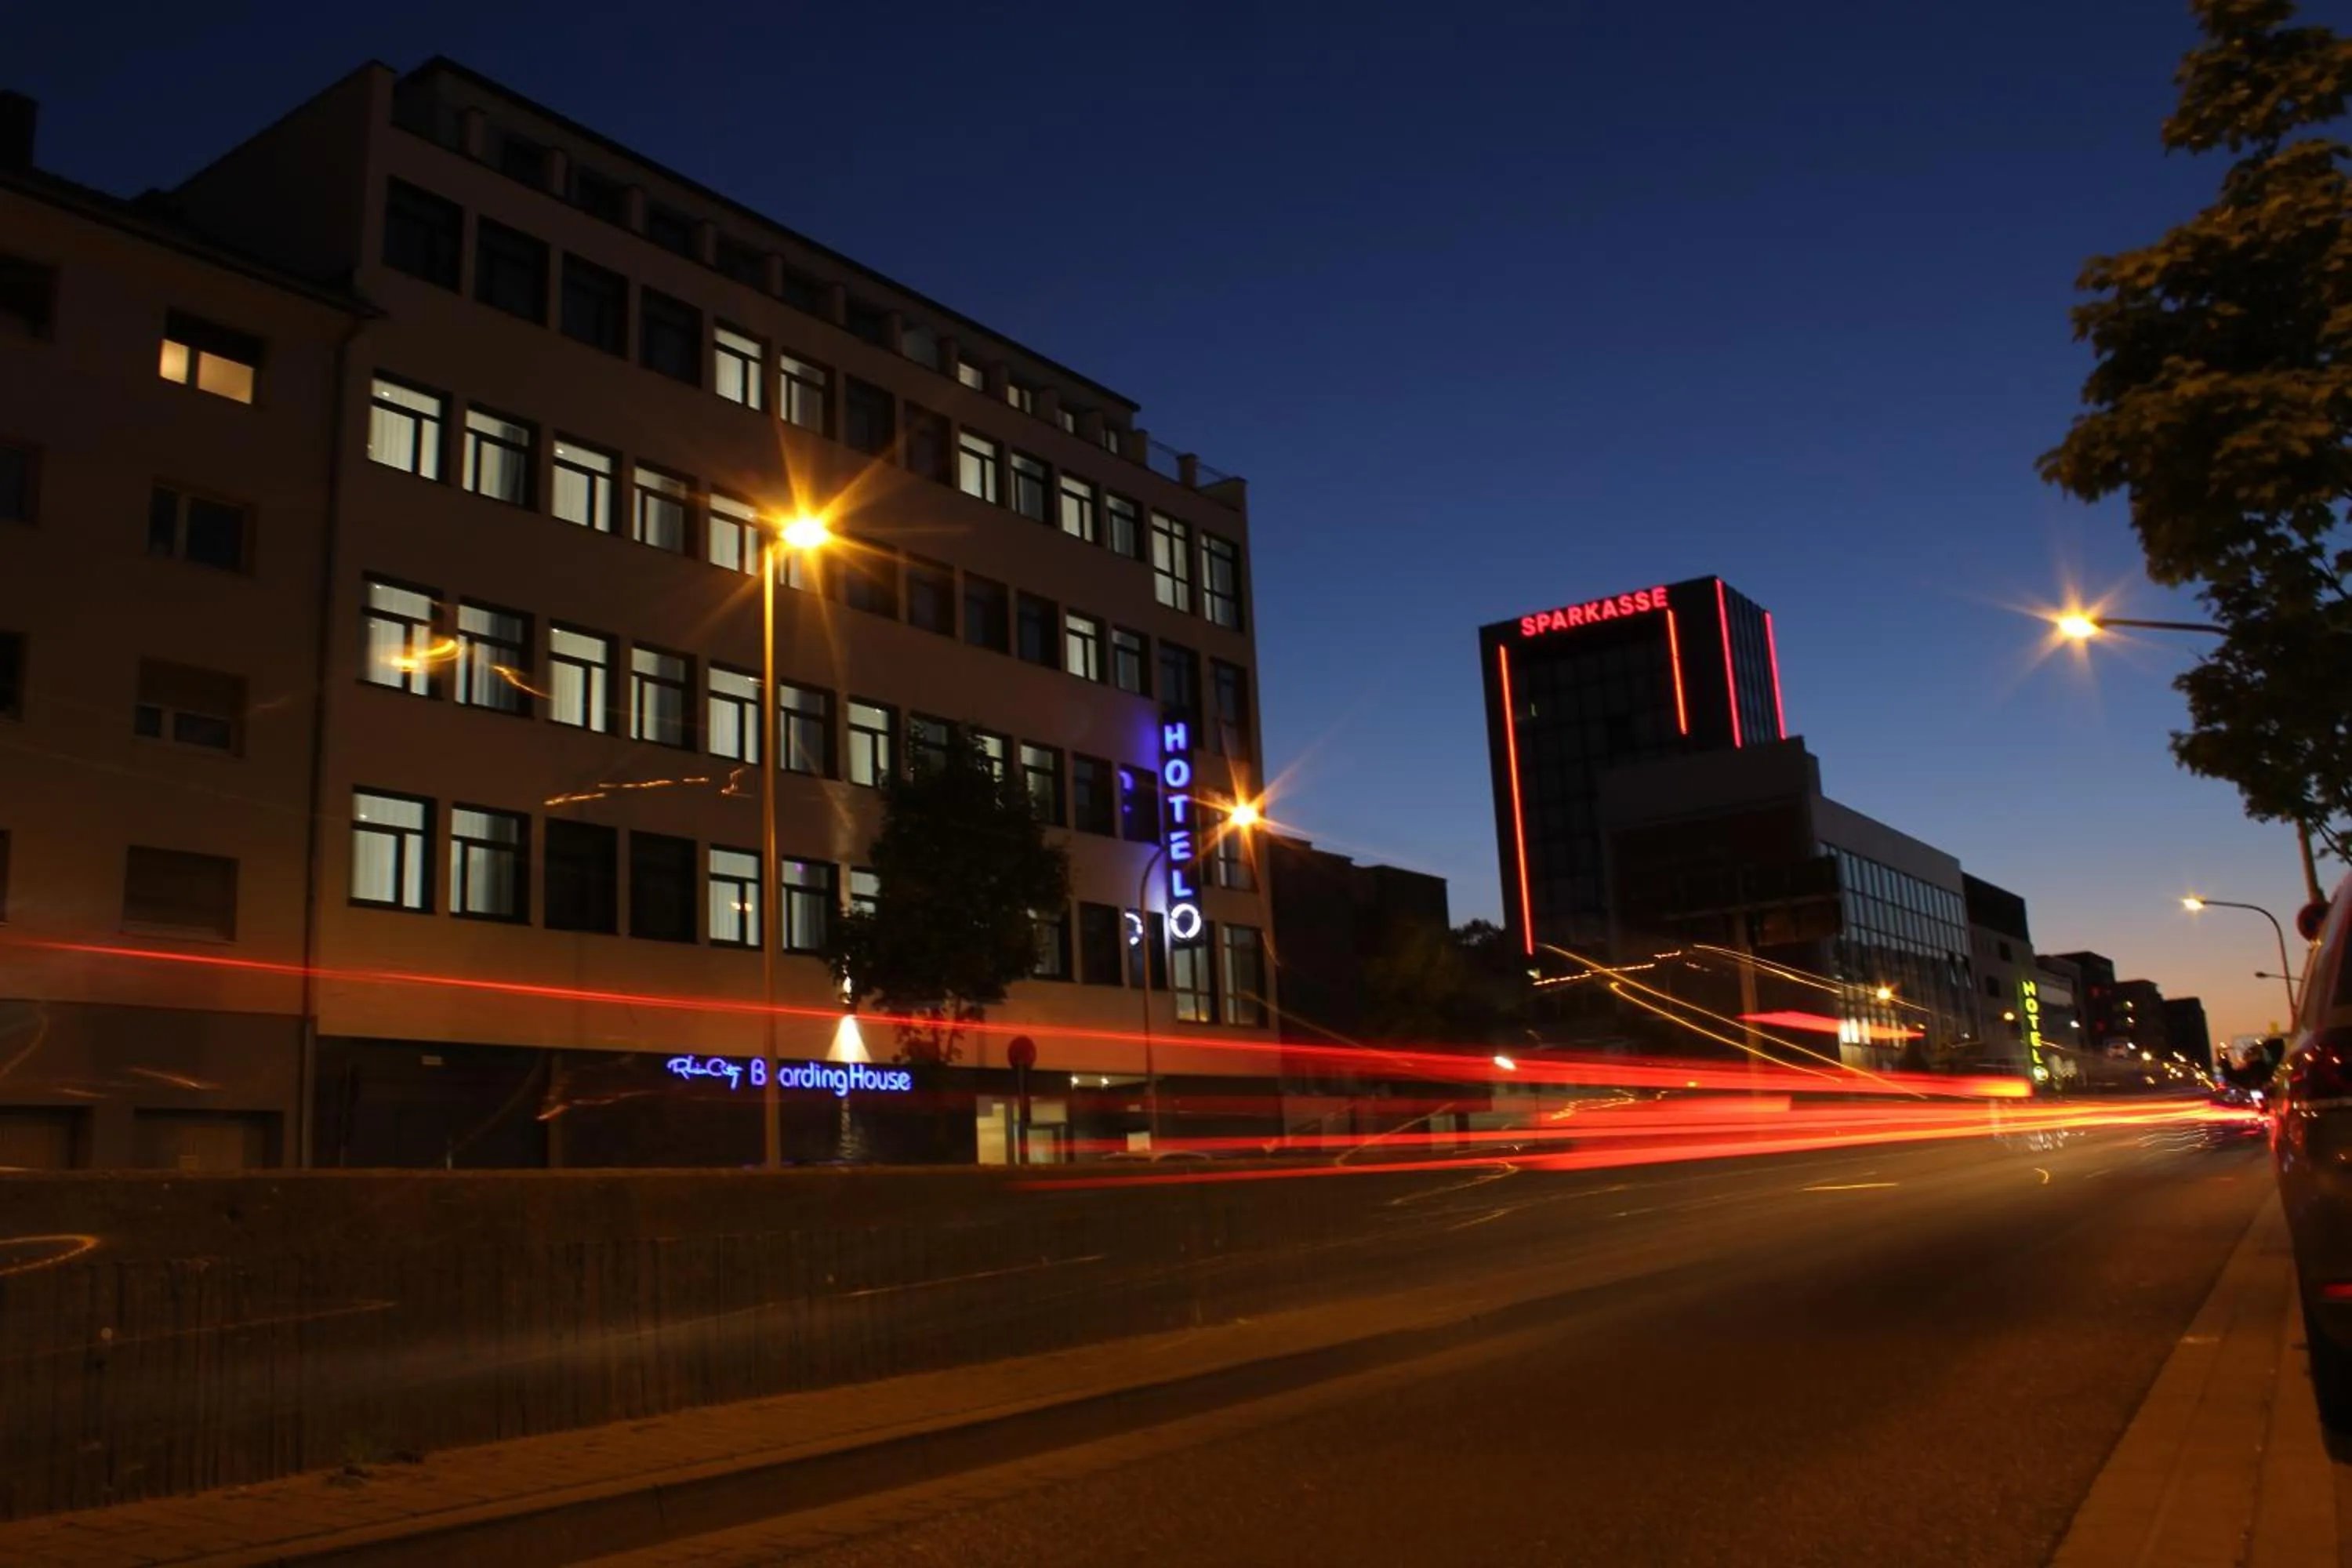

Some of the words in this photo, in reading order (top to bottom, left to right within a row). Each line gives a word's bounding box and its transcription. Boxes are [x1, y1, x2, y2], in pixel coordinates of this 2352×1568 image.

[1520, 586, 1668, 637] SPARKASSE
[2022, 980, 2043, 1064] HOTEL
[750, 1058, 912, 1097] BardingHouse
